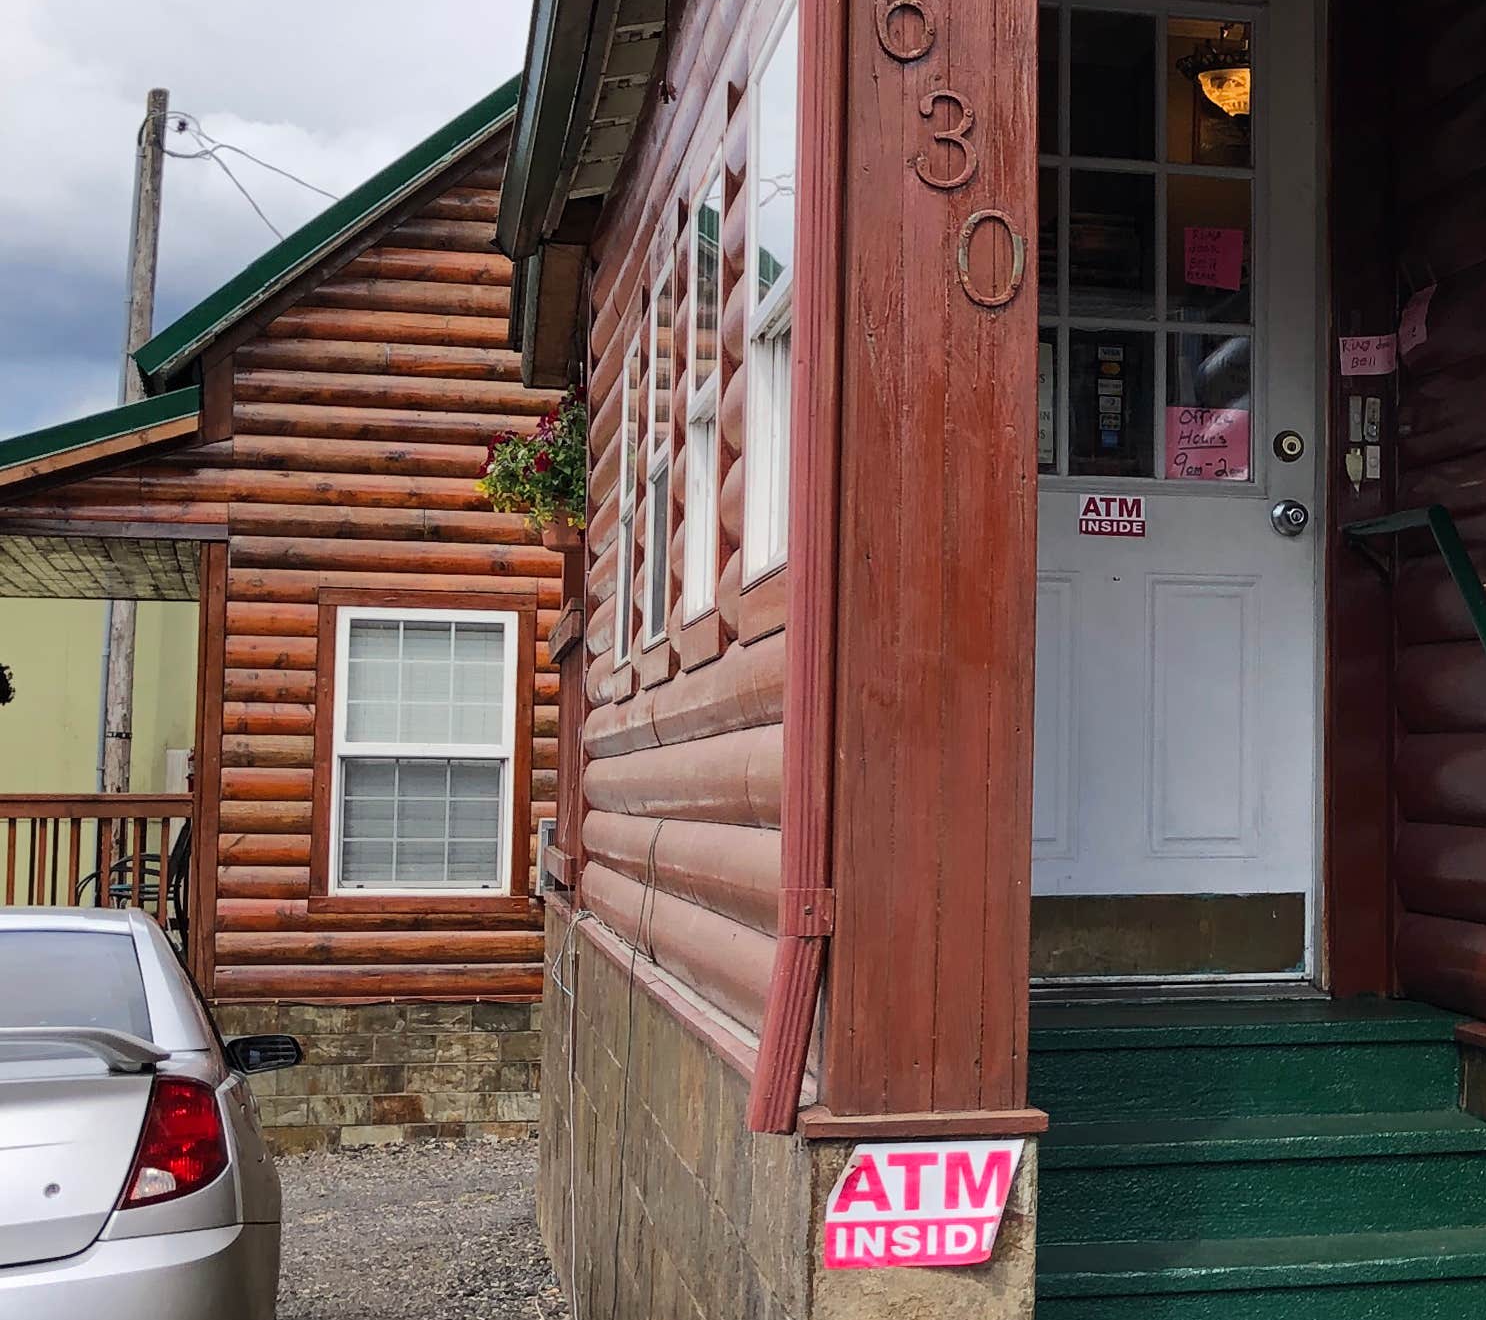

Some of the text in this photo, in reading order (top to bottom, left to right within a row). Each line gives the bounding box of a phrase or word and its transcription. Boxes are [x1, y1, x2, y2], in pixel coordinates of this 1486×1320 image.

[1082, 496, 1142, 518] ATM
[1081, 520, 1143, 533] INSIDE
[831, 1150, 1012, 1213] ATM
